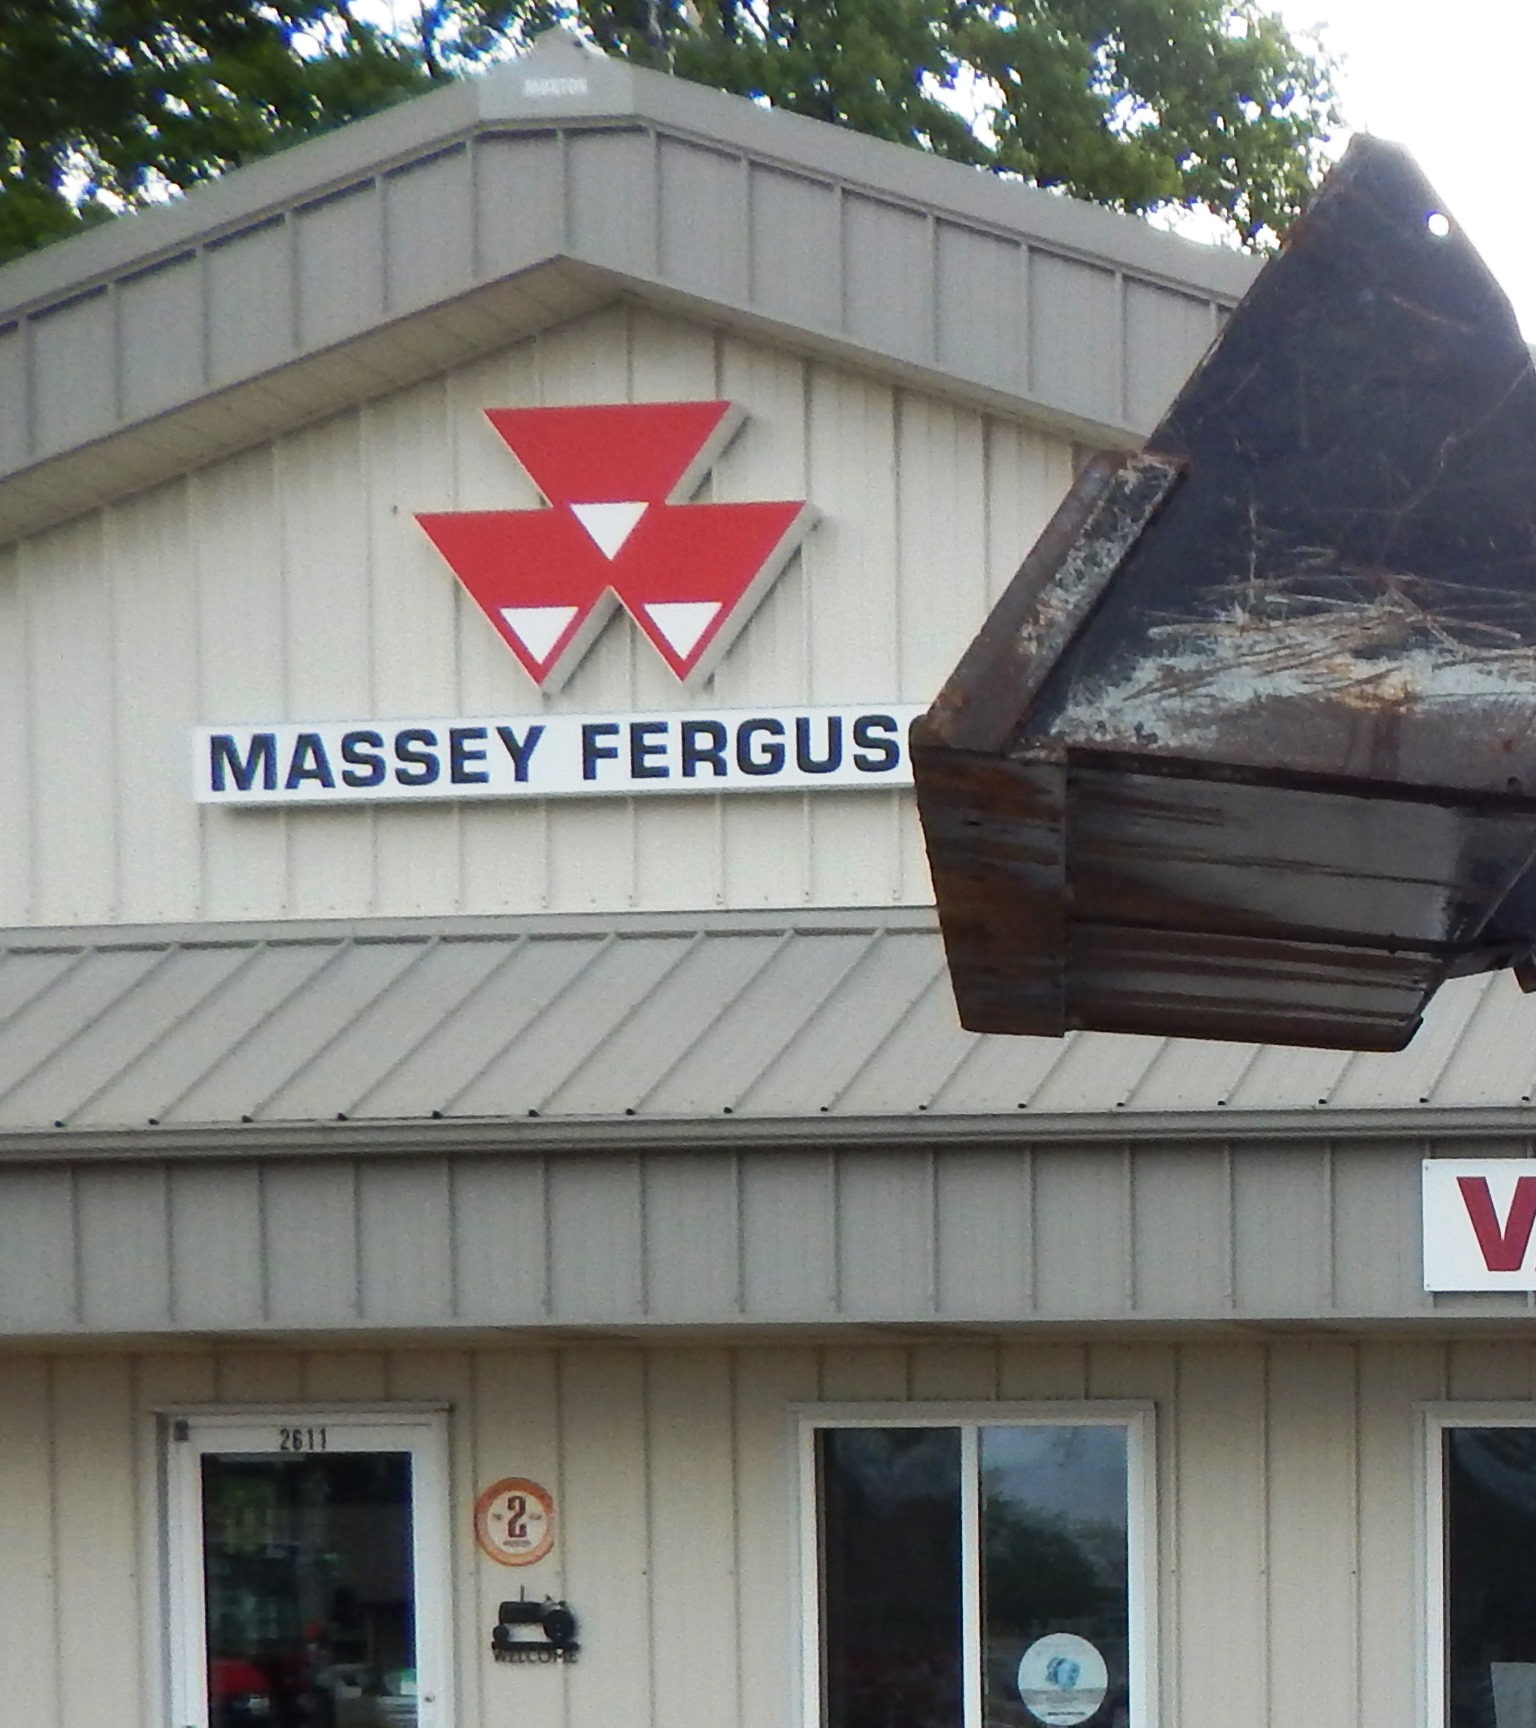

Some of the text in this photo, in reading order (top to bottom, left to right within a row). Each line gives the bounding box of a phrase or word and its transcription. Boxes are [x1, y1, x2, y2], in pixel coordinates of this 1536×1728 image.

[210, 714, 910, 791] MASSEY FERGUS
[280, 1427, 327, 1450] 2611
[507, 1495, 527, 1538] 2
